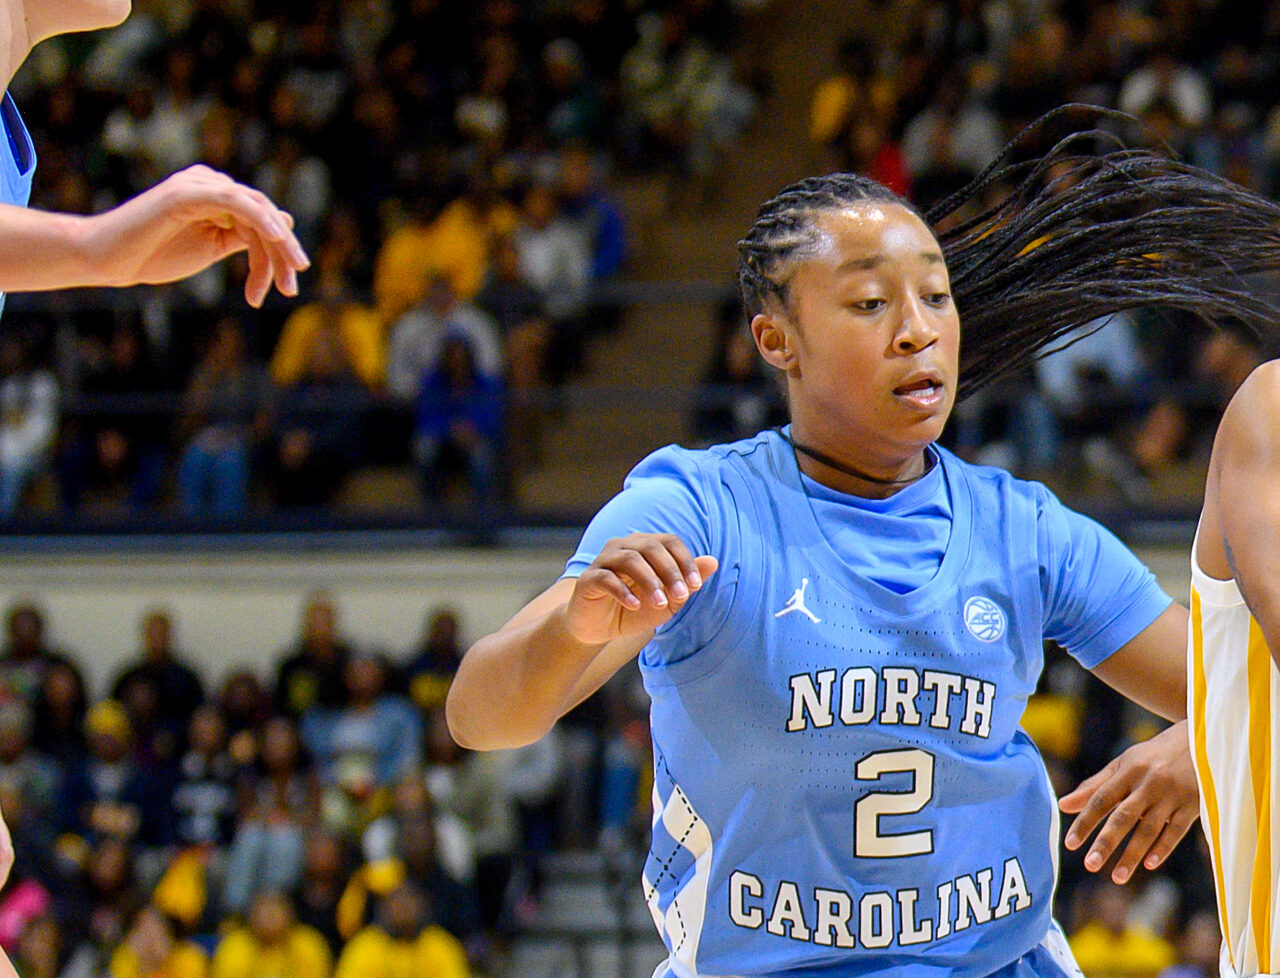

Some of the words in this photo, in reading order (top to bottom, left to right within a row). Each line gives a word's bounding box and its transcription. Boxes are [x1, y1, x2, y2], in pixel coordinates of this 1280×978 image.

[786, 666, 997, 739] NORTH
[854, 747, 935, 859] 2
[728, 857, 1032, 950] CAROLINA
